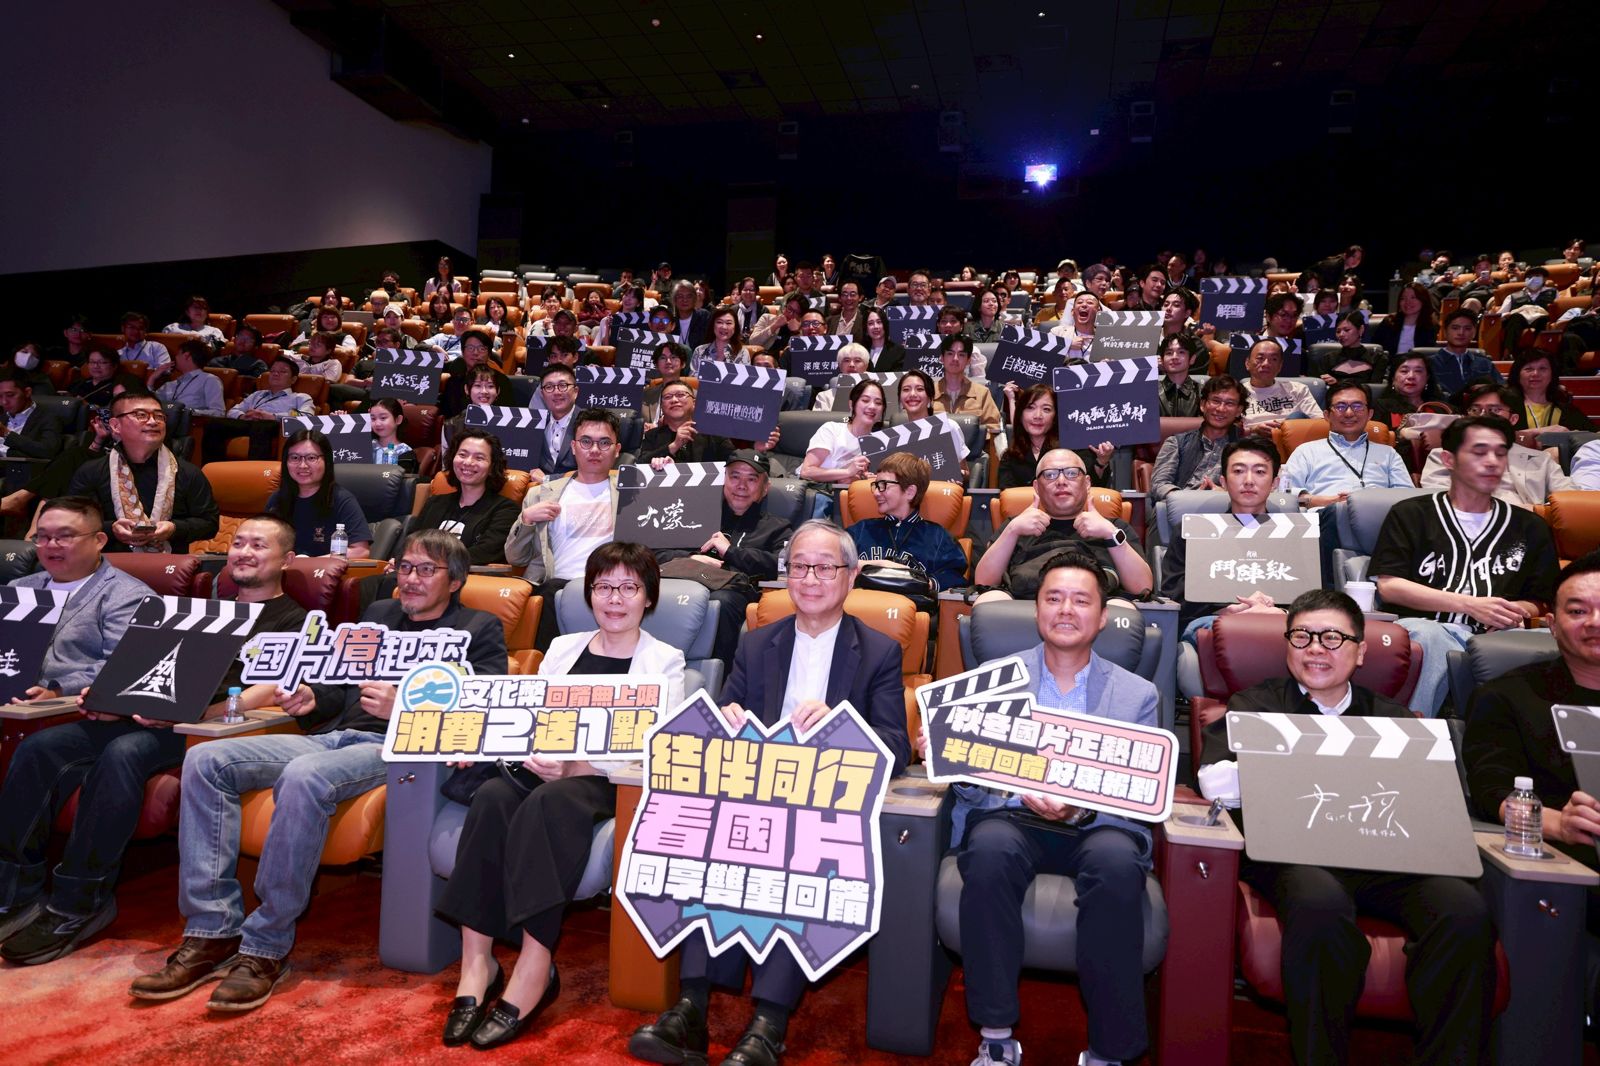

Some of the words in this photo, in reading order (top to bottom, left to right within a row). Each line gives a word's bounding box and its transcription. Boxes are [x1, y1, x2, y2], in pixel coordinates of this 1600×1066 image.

[1002, 355, 1048, 379] 自殺通告
[586, 393, 632, 407] 南方時光
[785, 484, 796, 492] 12
[942, 488, 951, 496] 11
[1099, 494, 1111, 503] 10
[164, 565, 175, 574] 15
[313, 568, 325, 579] 14
[499, 588, 511, 598] 13
[676, 594, 690, 606] 12
[886, 608, 898, 619] 11
[1114, 616, 1130, 629] 10
[1381, 634, 1392, 646] 9
[247, 627, 465, 692] 國片億起來
[392, 706, 658, 757] 消費2送1點
[650, 732, 878, 812] 結伴同行
[1325, 811, 1354, 823] Girl
[632, 791, 867, 880] 看國片
[624, 852, 870, 927] 同享雙重回饋
